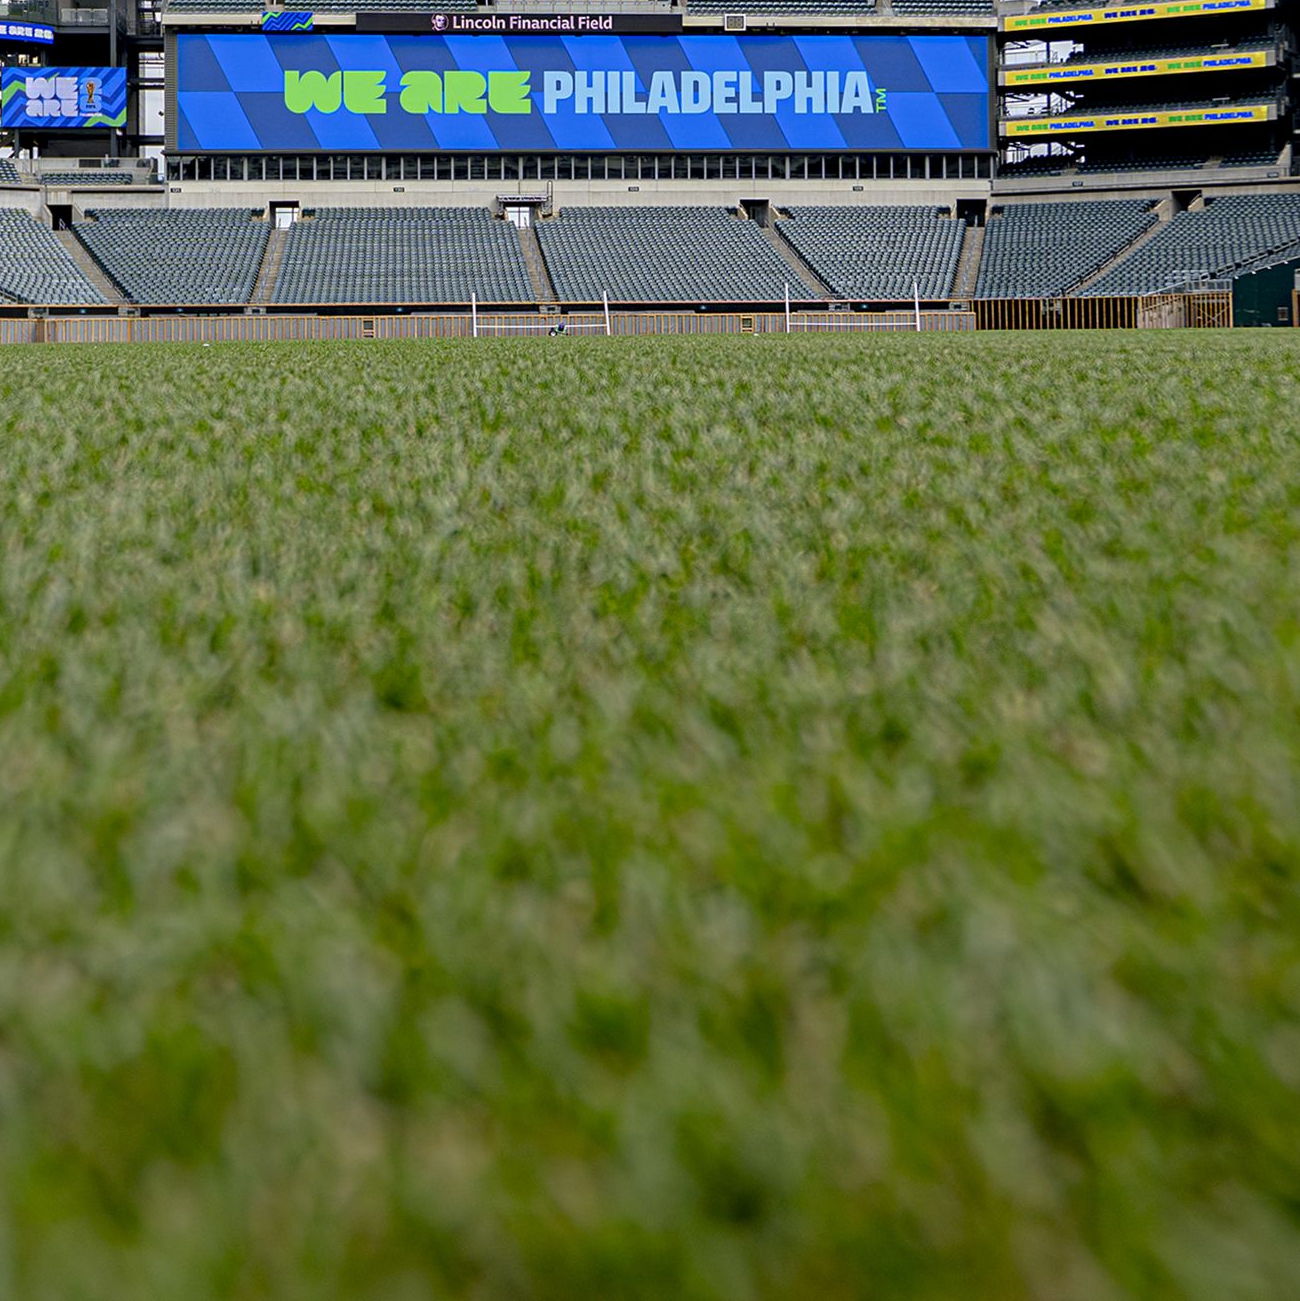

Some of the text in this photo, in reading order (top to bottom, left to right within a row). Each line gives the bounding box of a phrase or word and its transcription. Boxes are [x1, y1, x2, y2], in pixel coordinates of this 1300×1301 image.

[453, 15, 613, 30] Lincoln Financial Field
[25, 77, 78, 99] WE
[284, 71, 387, 114] WE
[543, 71, 874, 114] PHILADELPHIA
